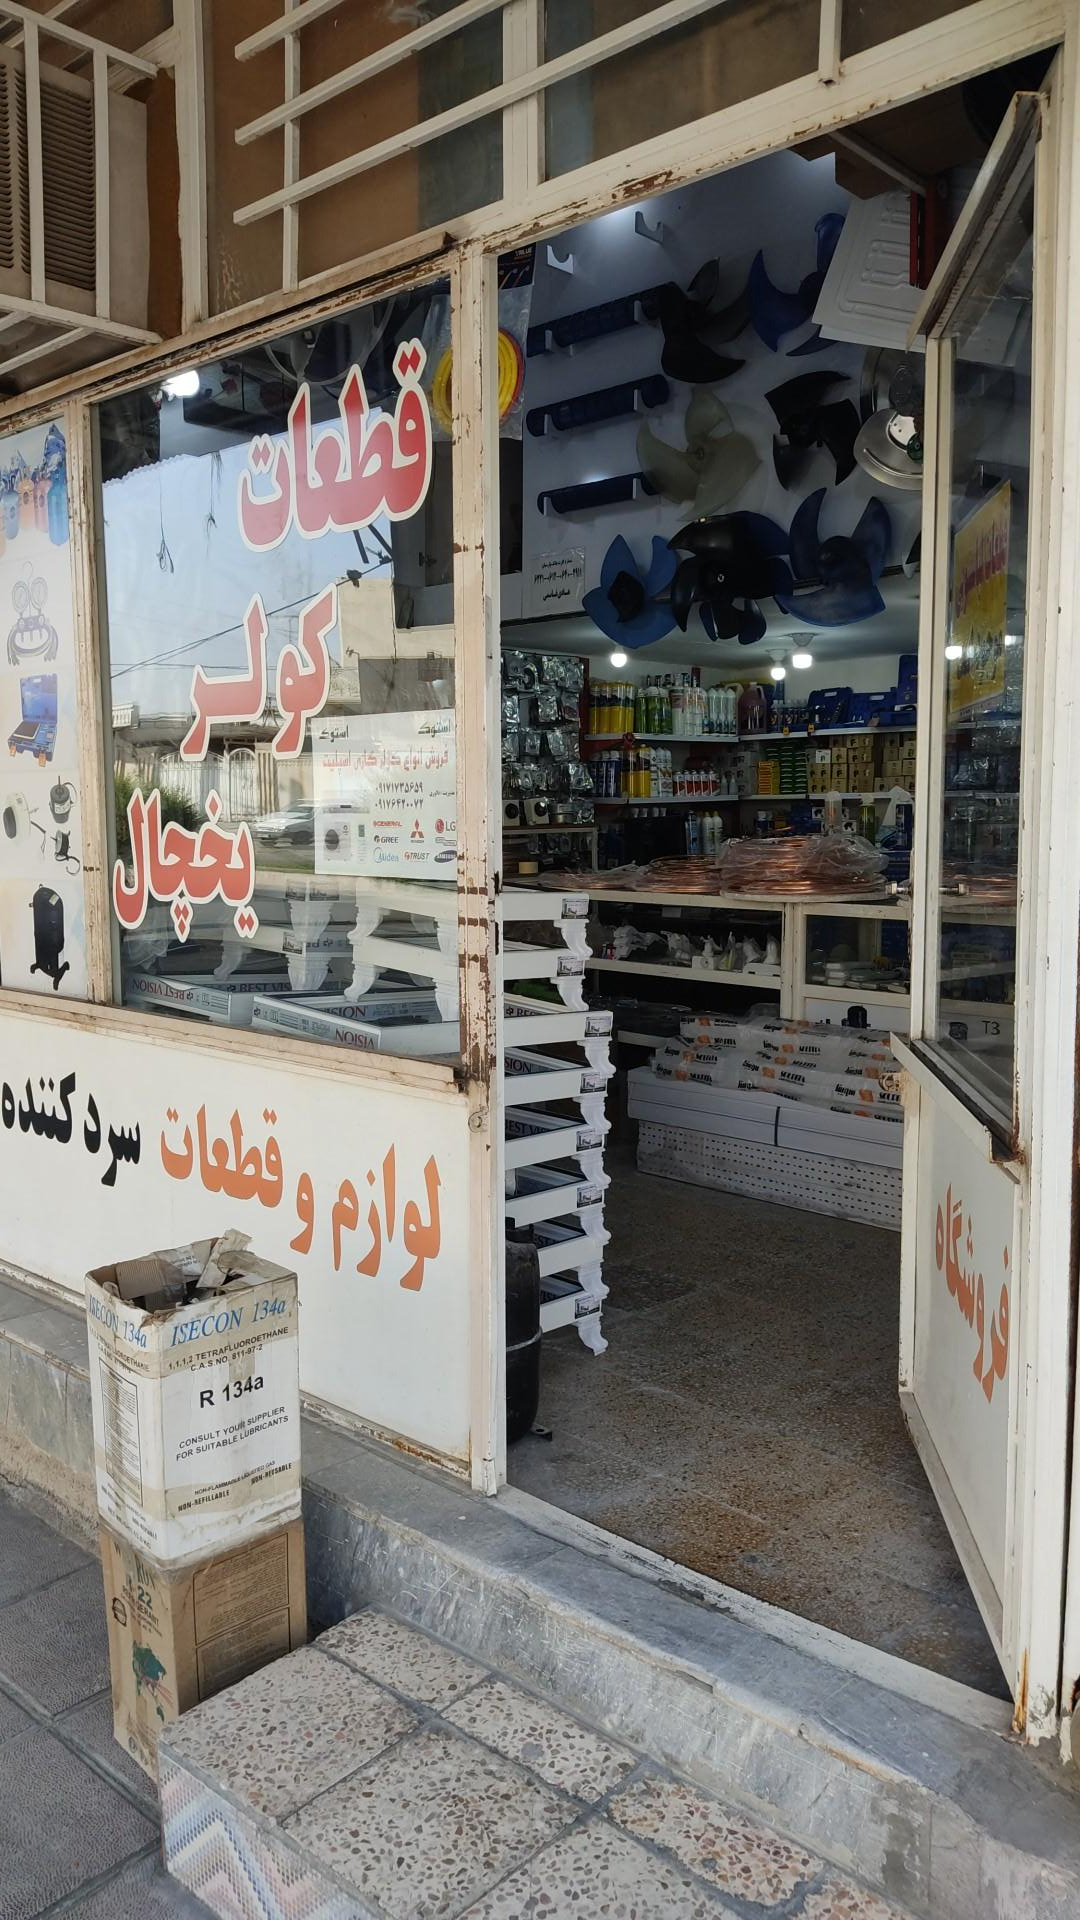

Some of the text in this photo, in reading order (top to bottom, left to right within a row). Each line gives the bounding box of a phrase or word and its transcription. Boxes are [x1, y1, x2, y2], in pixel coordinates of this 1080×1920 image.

[240, 342, 430, 549] قطعات
[183, 586, 336, 758] کولر
[445, 821, 456, 831] LG
[114, 790, 256, 940] یخچال
[409, 852, 430, 860] TRUST
[133, 980, 185, 1000] BEST VISION
[335, 1030, 375, 1049] VISION
[981, 1020, 1001, 1036] T3
[504, 1057, 531, 1073] SION
[160, 1104, 283, 1208] قطعات
[290, 1172, 314, 1254] و
[332, 1142, 441, 1291] لوازم
[936, 1181, 1009, 1404] فروشگاه
[89, 1295, 147, 1348] ISECON 134a
[171, 1297, 286, 1347] ISECON 134a
[169, 1326, 289, 1371] 1,1,1,2 TETRAFLUOROETHANE
[232, 1344, 263, 1361] 811-97-2
[200, 1374, 264, 1409] R 134a
[176, 1415, 289, 1462] FOR SUITABLE LUBRICANTS
[179, 1406, 285, 1449] CONSULT YOUR SUPPLIER
[251, 1462, 292, 1485] NON-REUSABLE
[178, 1489, 231, 1512] NON-REFILLABLE
[137, 1584, 153, 1610] 22
